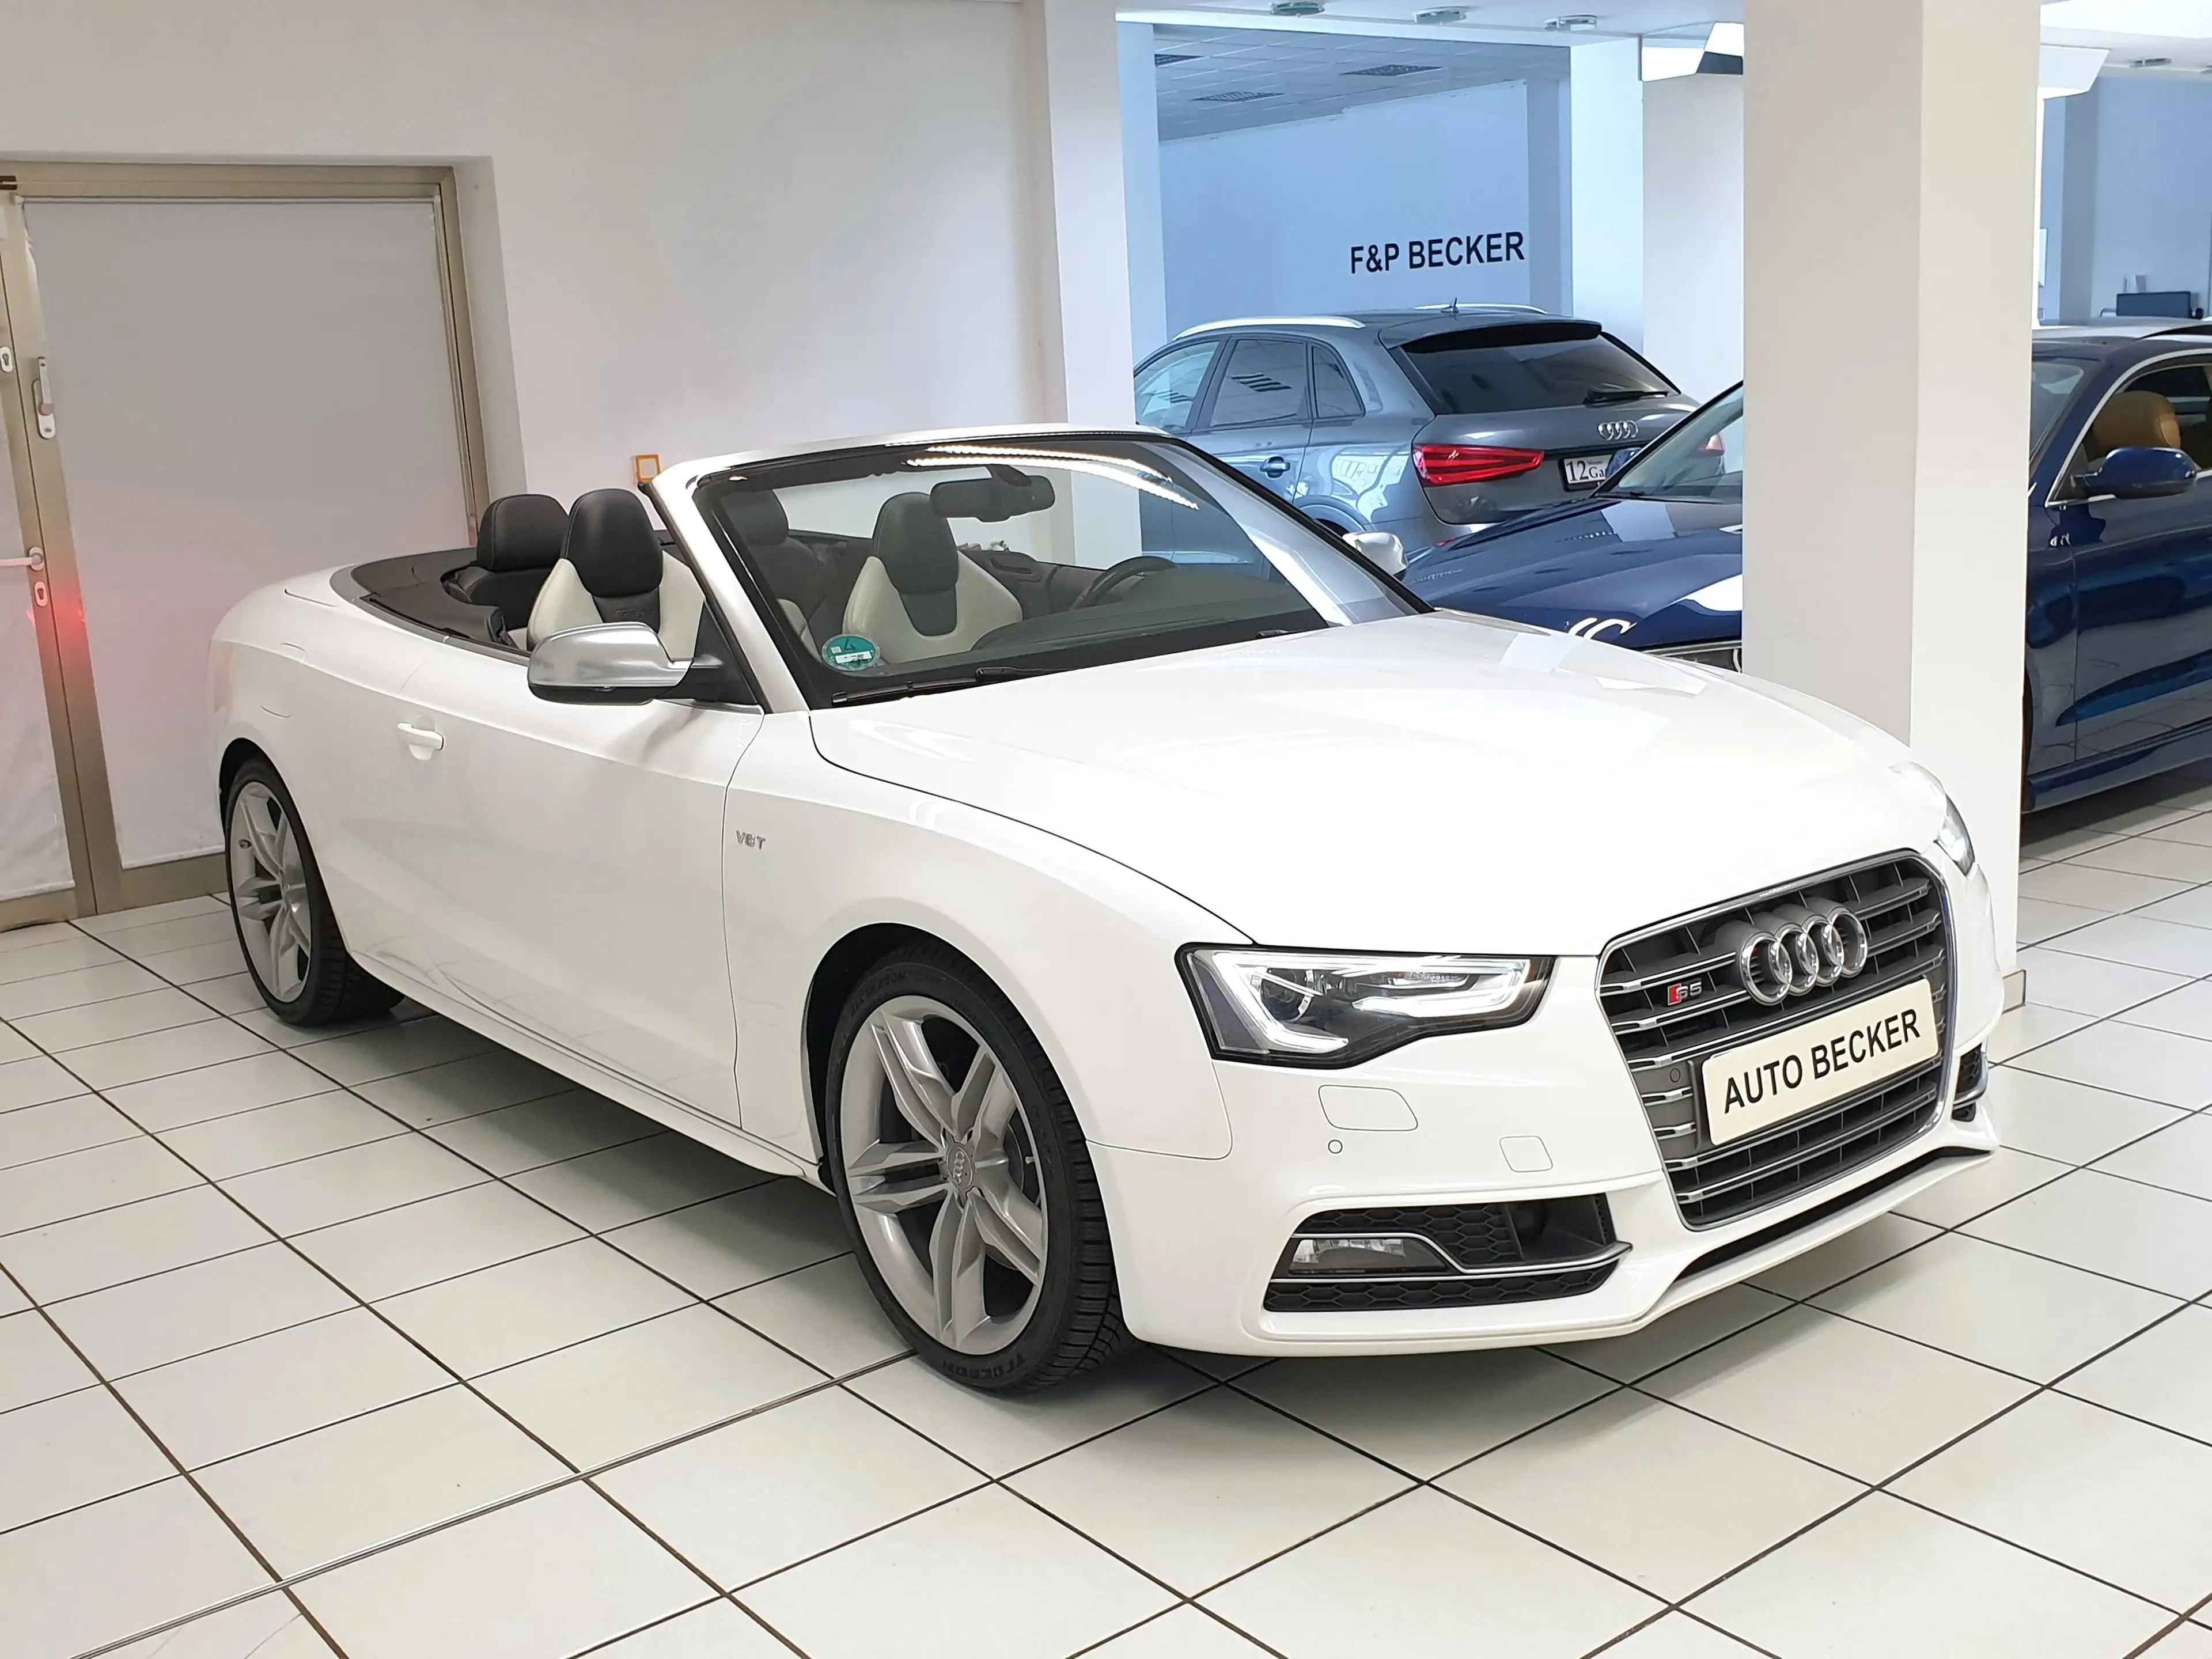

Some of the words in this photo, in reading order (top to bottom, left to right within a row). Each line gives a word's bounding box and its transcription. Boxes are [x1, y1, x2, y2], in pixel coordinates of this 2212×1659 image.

[1351, 243, 1400, 274] F&P
[1409, 231, 1525, 270] BECKER
[1674, 982, 1702, 1001] S5
[1724, 1054, 1803, 1114] AUTO
[1811, 1009, 1921, 1080] BECKER
